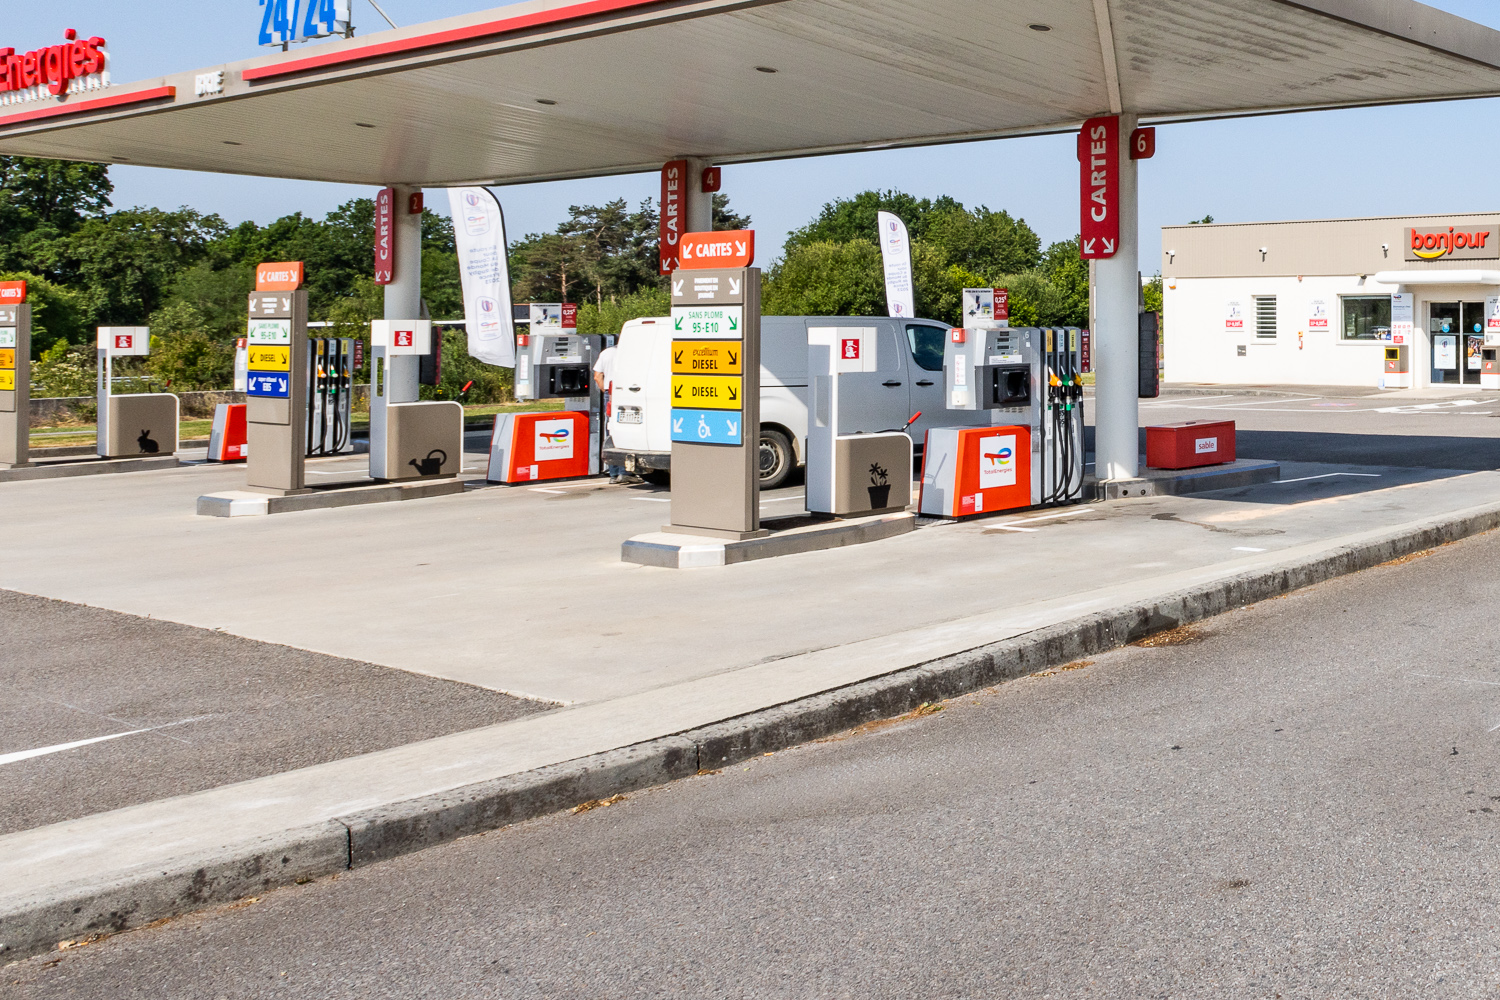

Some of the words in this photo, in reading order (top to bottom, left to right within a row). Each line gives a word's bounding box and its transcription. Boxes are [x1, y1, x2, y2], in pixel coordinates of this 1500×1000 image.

[1137, 133, 1147, 153] 6
[706, 172, 714, 187] 4
[1090, 124, 1107, 223] CARTES
[412, 197, 418, 210] 2
[666, 167, 678, 246] CARTES
[380, 194, 389, 261] CARTES
[1411, 226, 1490, 254] bonjour
[695, 242, 733, 258] CARTES
[266, 271, 289, 282] CARTES
[688, 311, 703, 319] SANS
[704, 311, 724, 319] PLOMB
[692, 322, 719, 333] 95-E10
[260, 353, 276, 362] DIESEL
[692, 359, 719, 370] DIESEL
[692, 386, 719, 397] DIESEL
[1198, 440, 1215, 450] sable
[984, 467, 1013, 475] TotalEnergies
